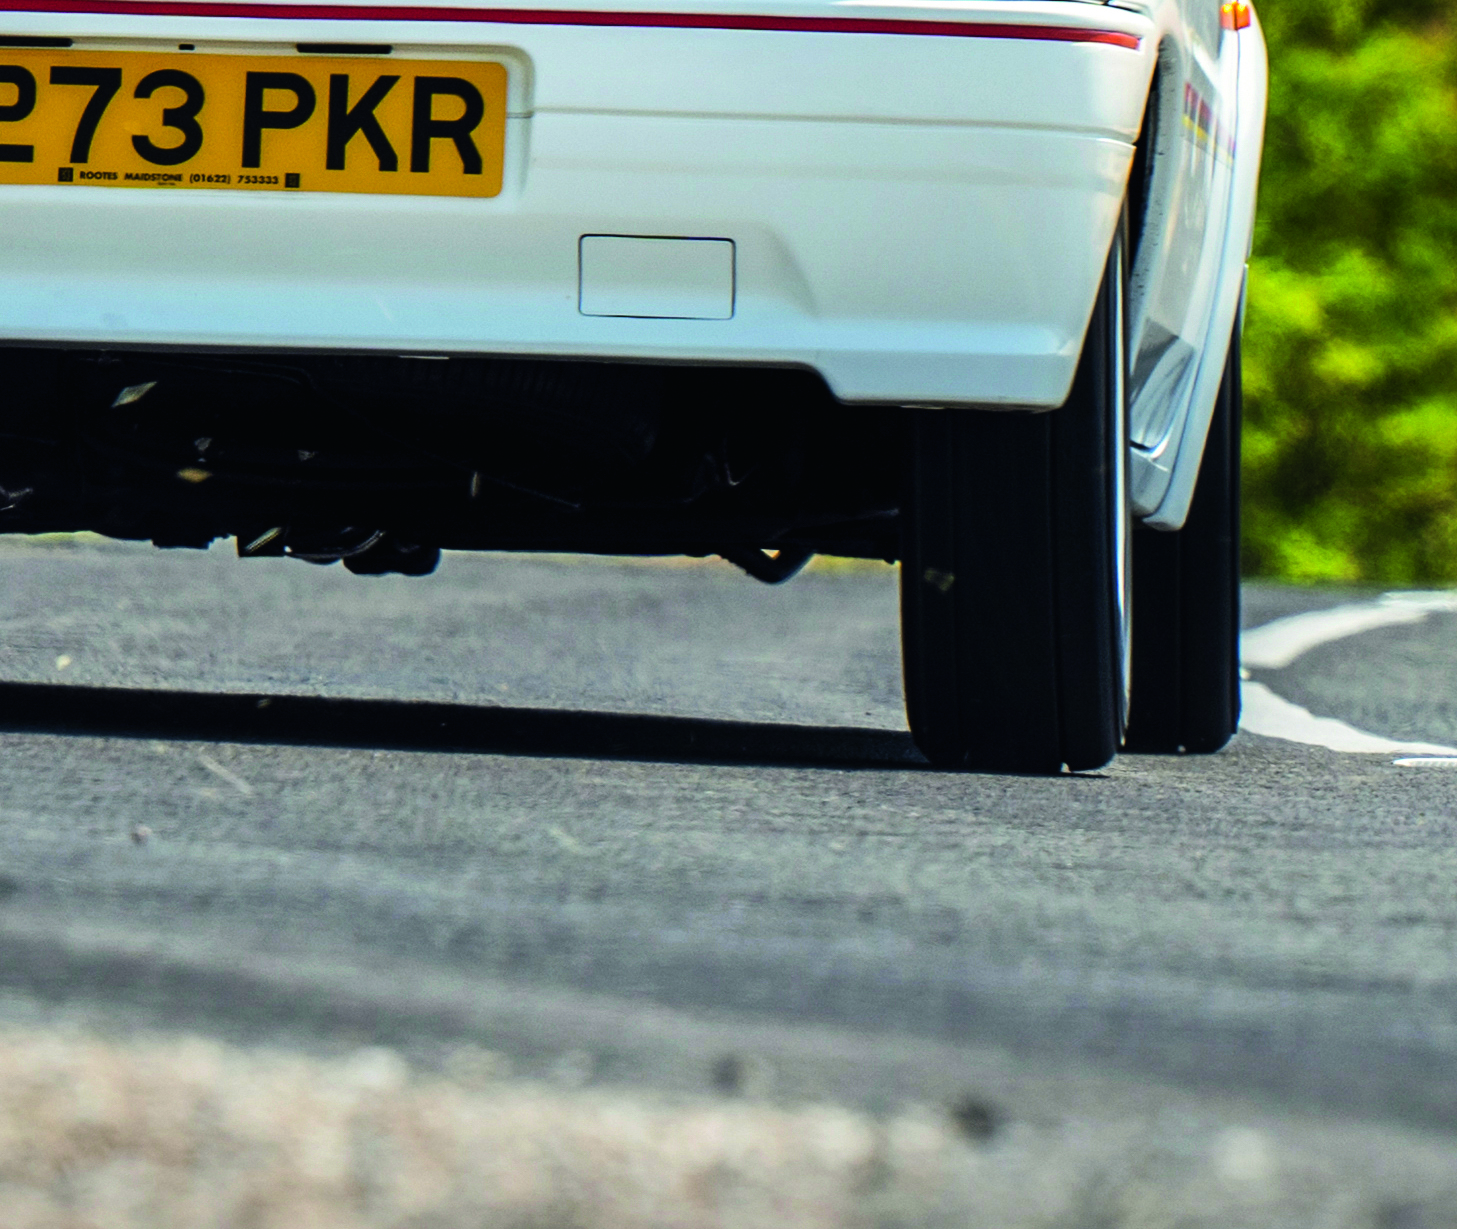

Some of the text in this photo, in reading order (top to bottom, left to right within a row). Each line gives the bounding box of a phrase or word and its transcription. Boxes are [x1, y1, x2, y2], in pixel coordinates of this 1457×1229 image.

[240, 70, 486, 176] PKR
[79, 170, 118, 181] ROOTES
[123, 172, 184, 183] MAIDSTONE
[189, 173, 232, 185] (01622)
